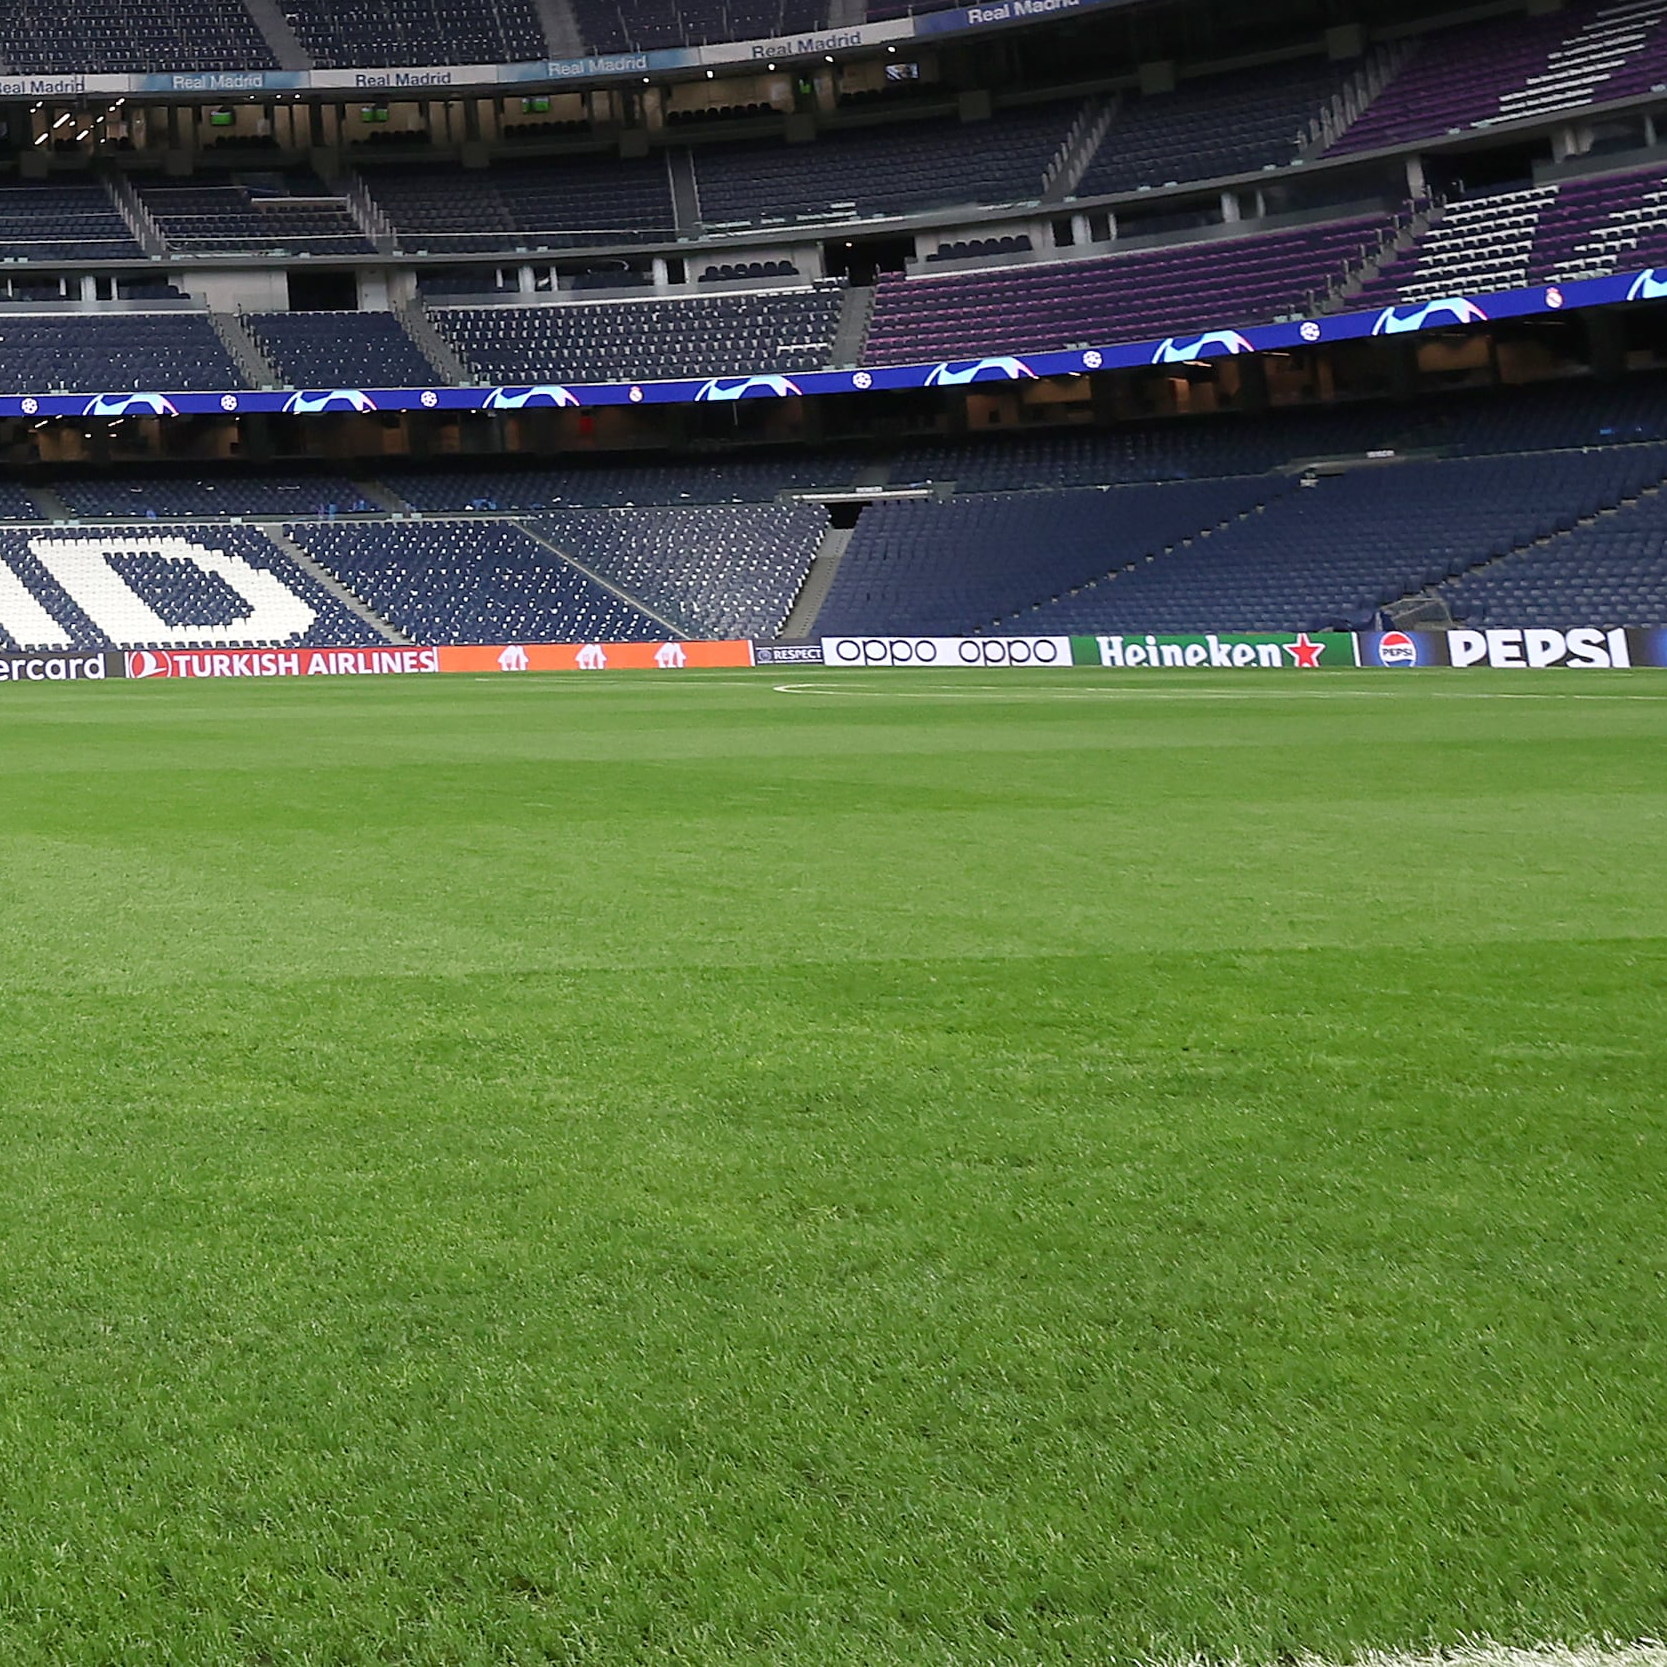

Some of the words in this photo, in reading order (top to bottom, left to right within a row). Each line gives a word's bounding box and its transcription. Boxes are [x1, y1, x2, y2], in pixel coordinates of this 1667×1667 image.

[967, 5, 1009, 24] Real
[752, 43, 792, 59] Real
[797, 32, 862, 54] Madrid
[547, 60, 583, 76] Real
[589, 55, 647, 73] Madrid
[30, 79, 85, 94] Madrid
[173, 75, 207, 89] Real
[211, 74, 264, 88] Madrid
[356, 73, 390, 87] Real
[395, 71, 451, 86] Madrid
[773, 648, 823, 661] RESPECT
[836, 639, 937, 666] oppo
[959, 639, 1057, 666] oppo
[1096, 634, 1283, 667] Heineken
[1382, 648, 1412, 658] PEPSI
[1447, 627, 1632, 669] PEPSI
[173, 652, 299, 678] TURKISH
[307, 650, 433, 676] AIRLINES
